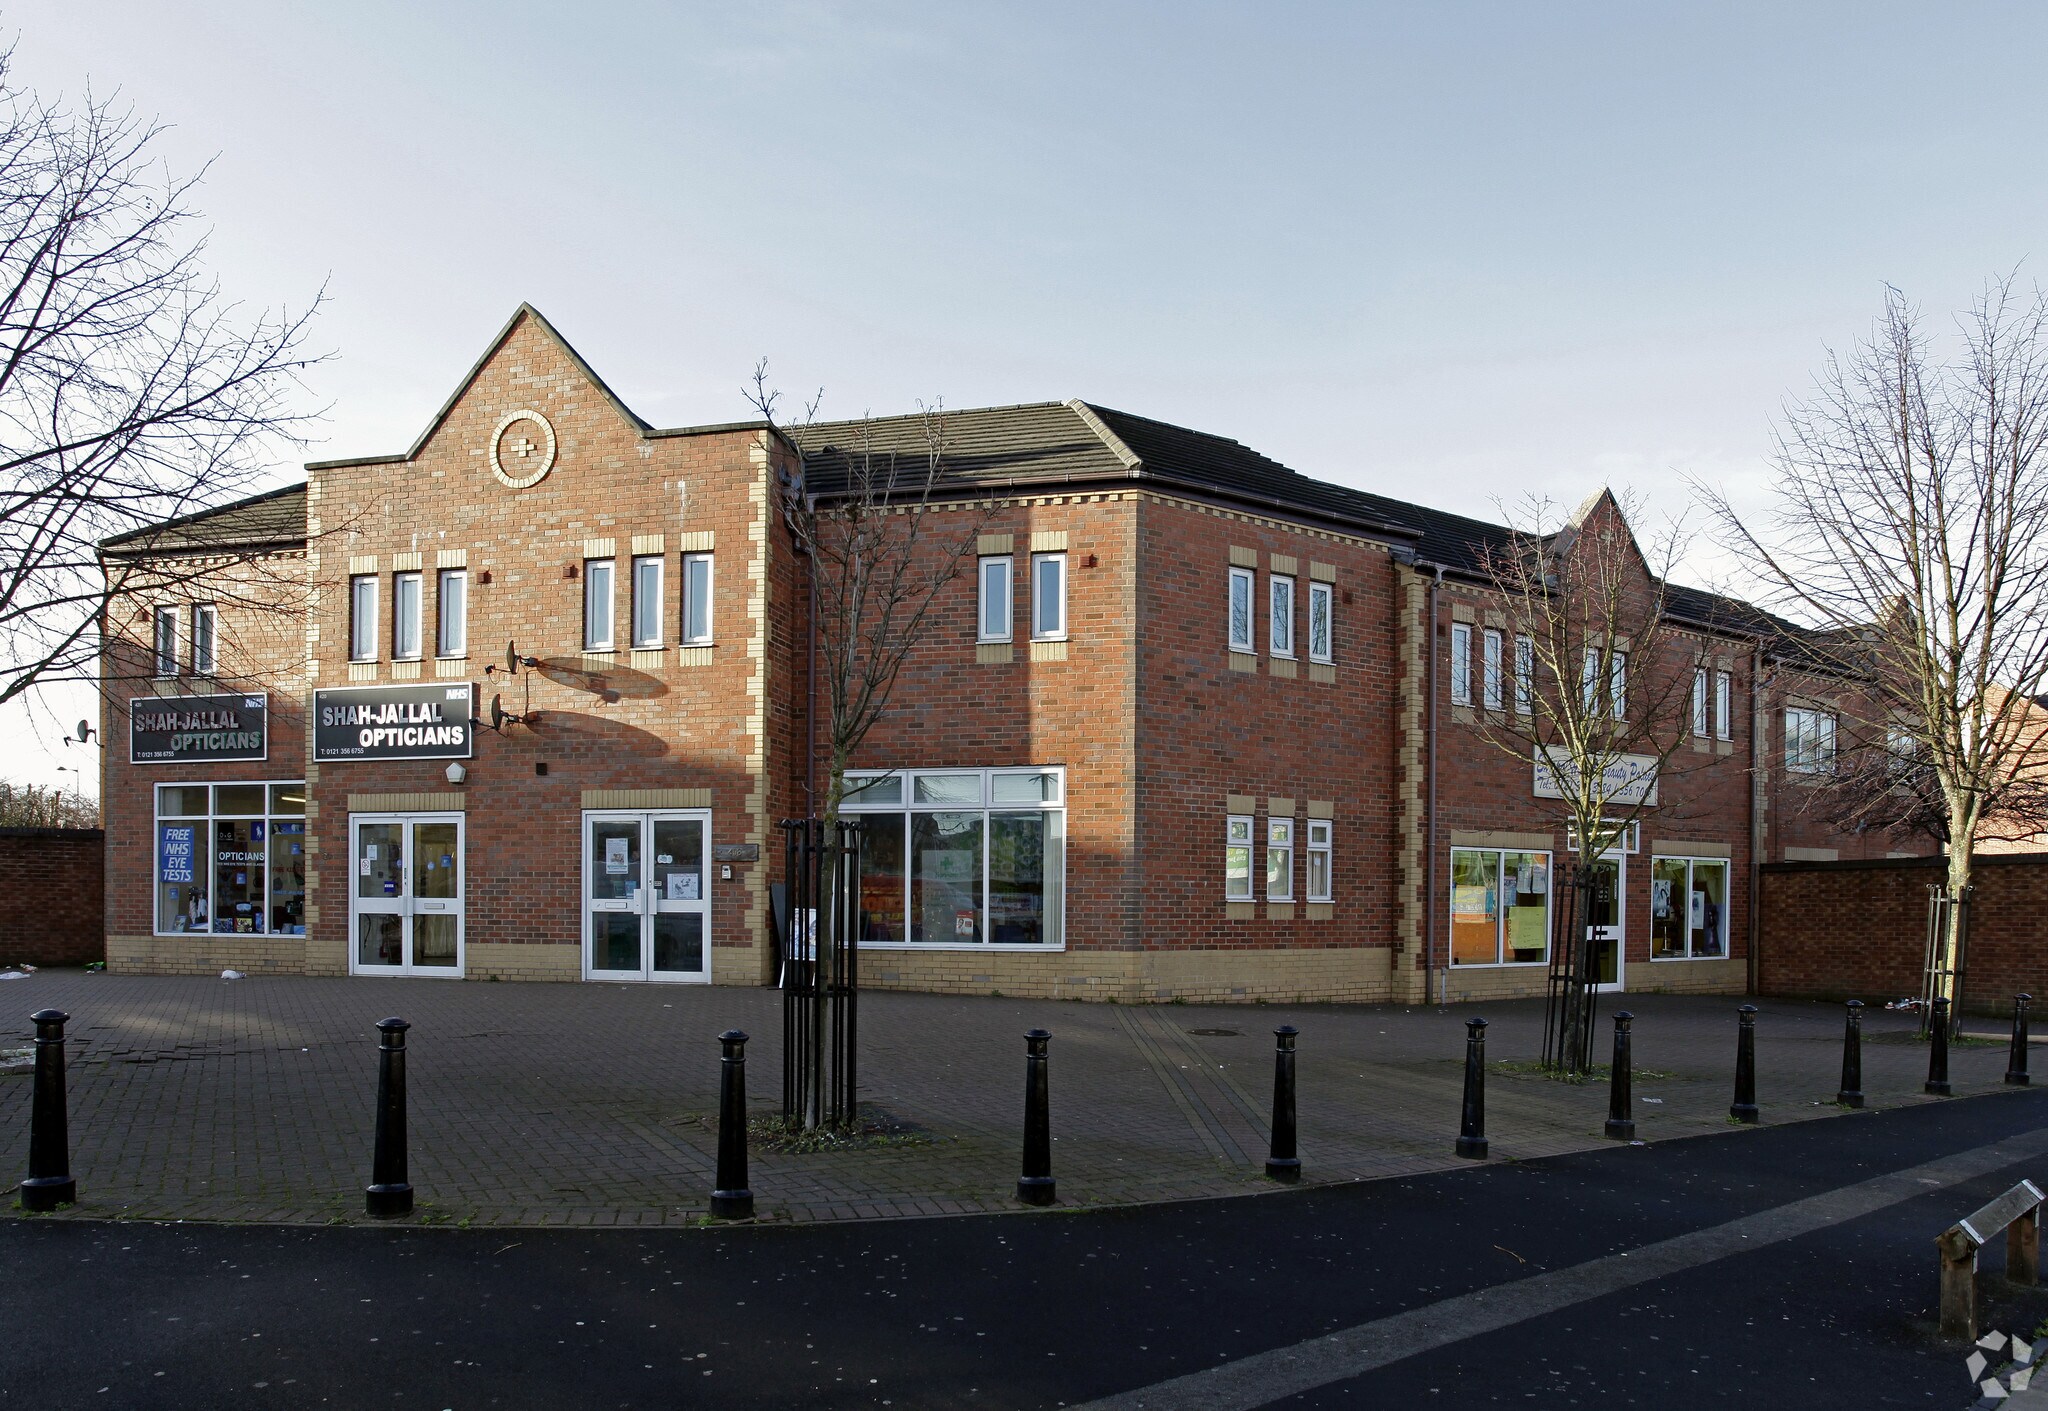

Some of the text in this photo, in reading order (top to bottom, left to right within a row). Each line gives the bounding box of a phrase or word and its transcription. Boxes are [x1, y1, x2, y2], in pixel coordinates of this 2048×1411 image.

[446, 689, 467, 700] NHS
[245, 698, 264, 708] NHS
[322, 703, 443, 727] SHAH-JALLAL
[135, 711, 239, 732] SHAH-JALLAL
[170, 732, 262, 751] OPTICIANS
[359, 726, 464, 748] OPTICIANS
[166, 828, 191, 840] FREE
[165, 843, 189, 855] NHS
[218, 851, 265, 861] OPTICIANS
[168, 857, 187, 869] EYE
[163, 869, 192, 881] TESTS
